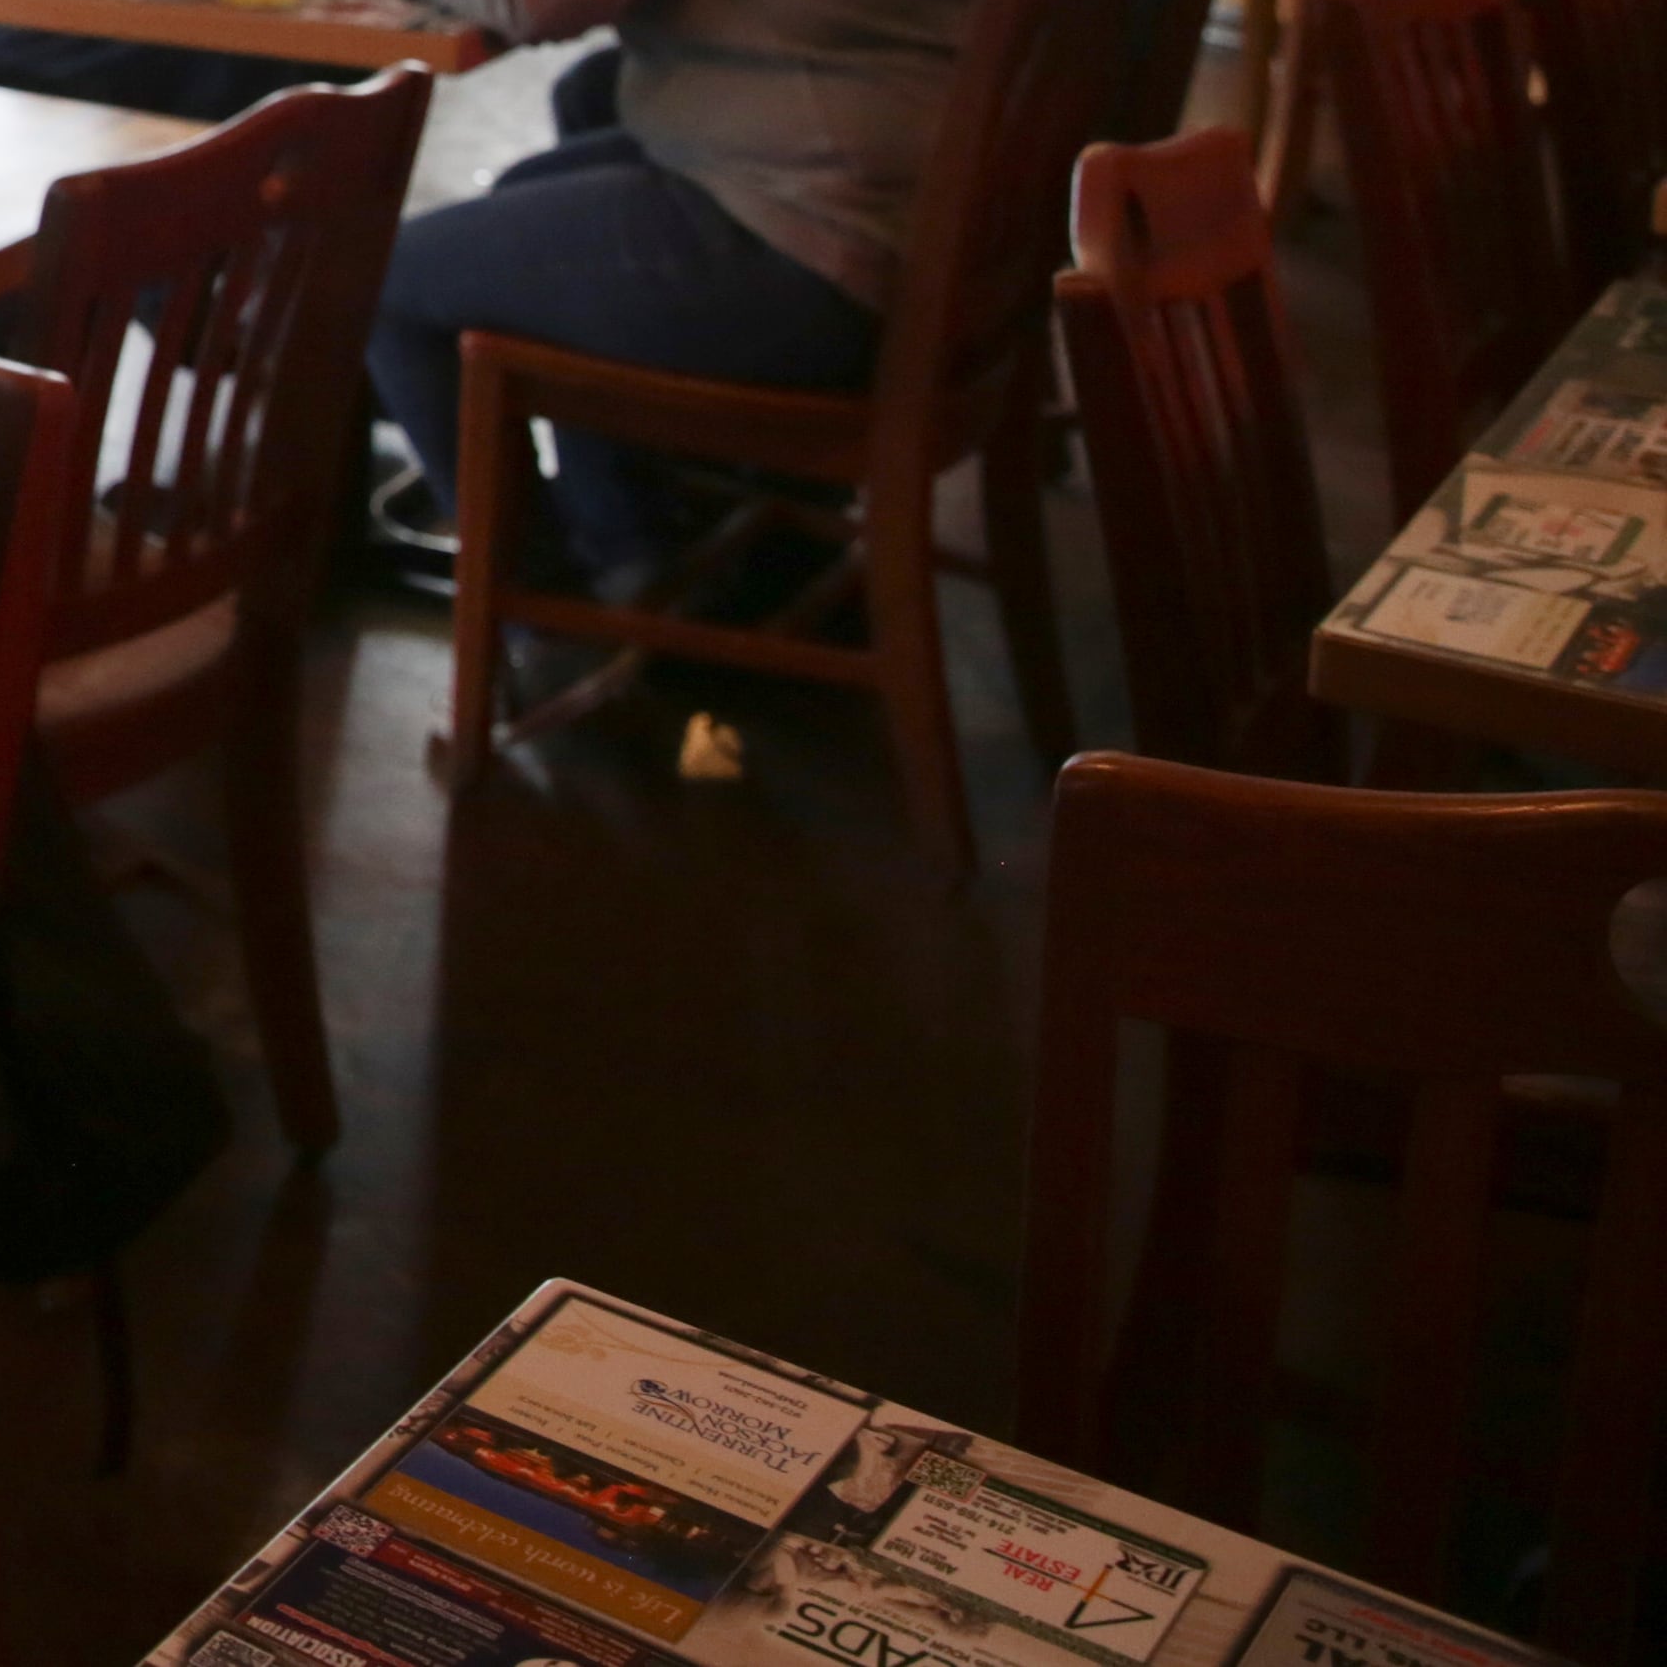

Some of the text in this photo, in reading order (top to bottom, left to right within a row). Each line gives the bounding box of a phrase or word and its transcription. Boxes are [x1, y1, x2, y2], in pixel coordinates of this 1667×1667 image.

[668, 1389, 792, 1439] MORROW
[632, 1401, 791, 1473] TURRENTINE
[701, 1414, 821, 1466] JACKSON
[387, 1484, 683, 1624] Life is worth celebrating
[883, 1537, 958, 1575] Allen Hall
[997, 1539, 1082, 1580] ESTATE
[1003, 1562, 1055, 1592] REAL
[848, 1605, 864, 1616] in
[864, 1612, 929, 1643] business
[1304, 1617, 1367, 1650] LLC
